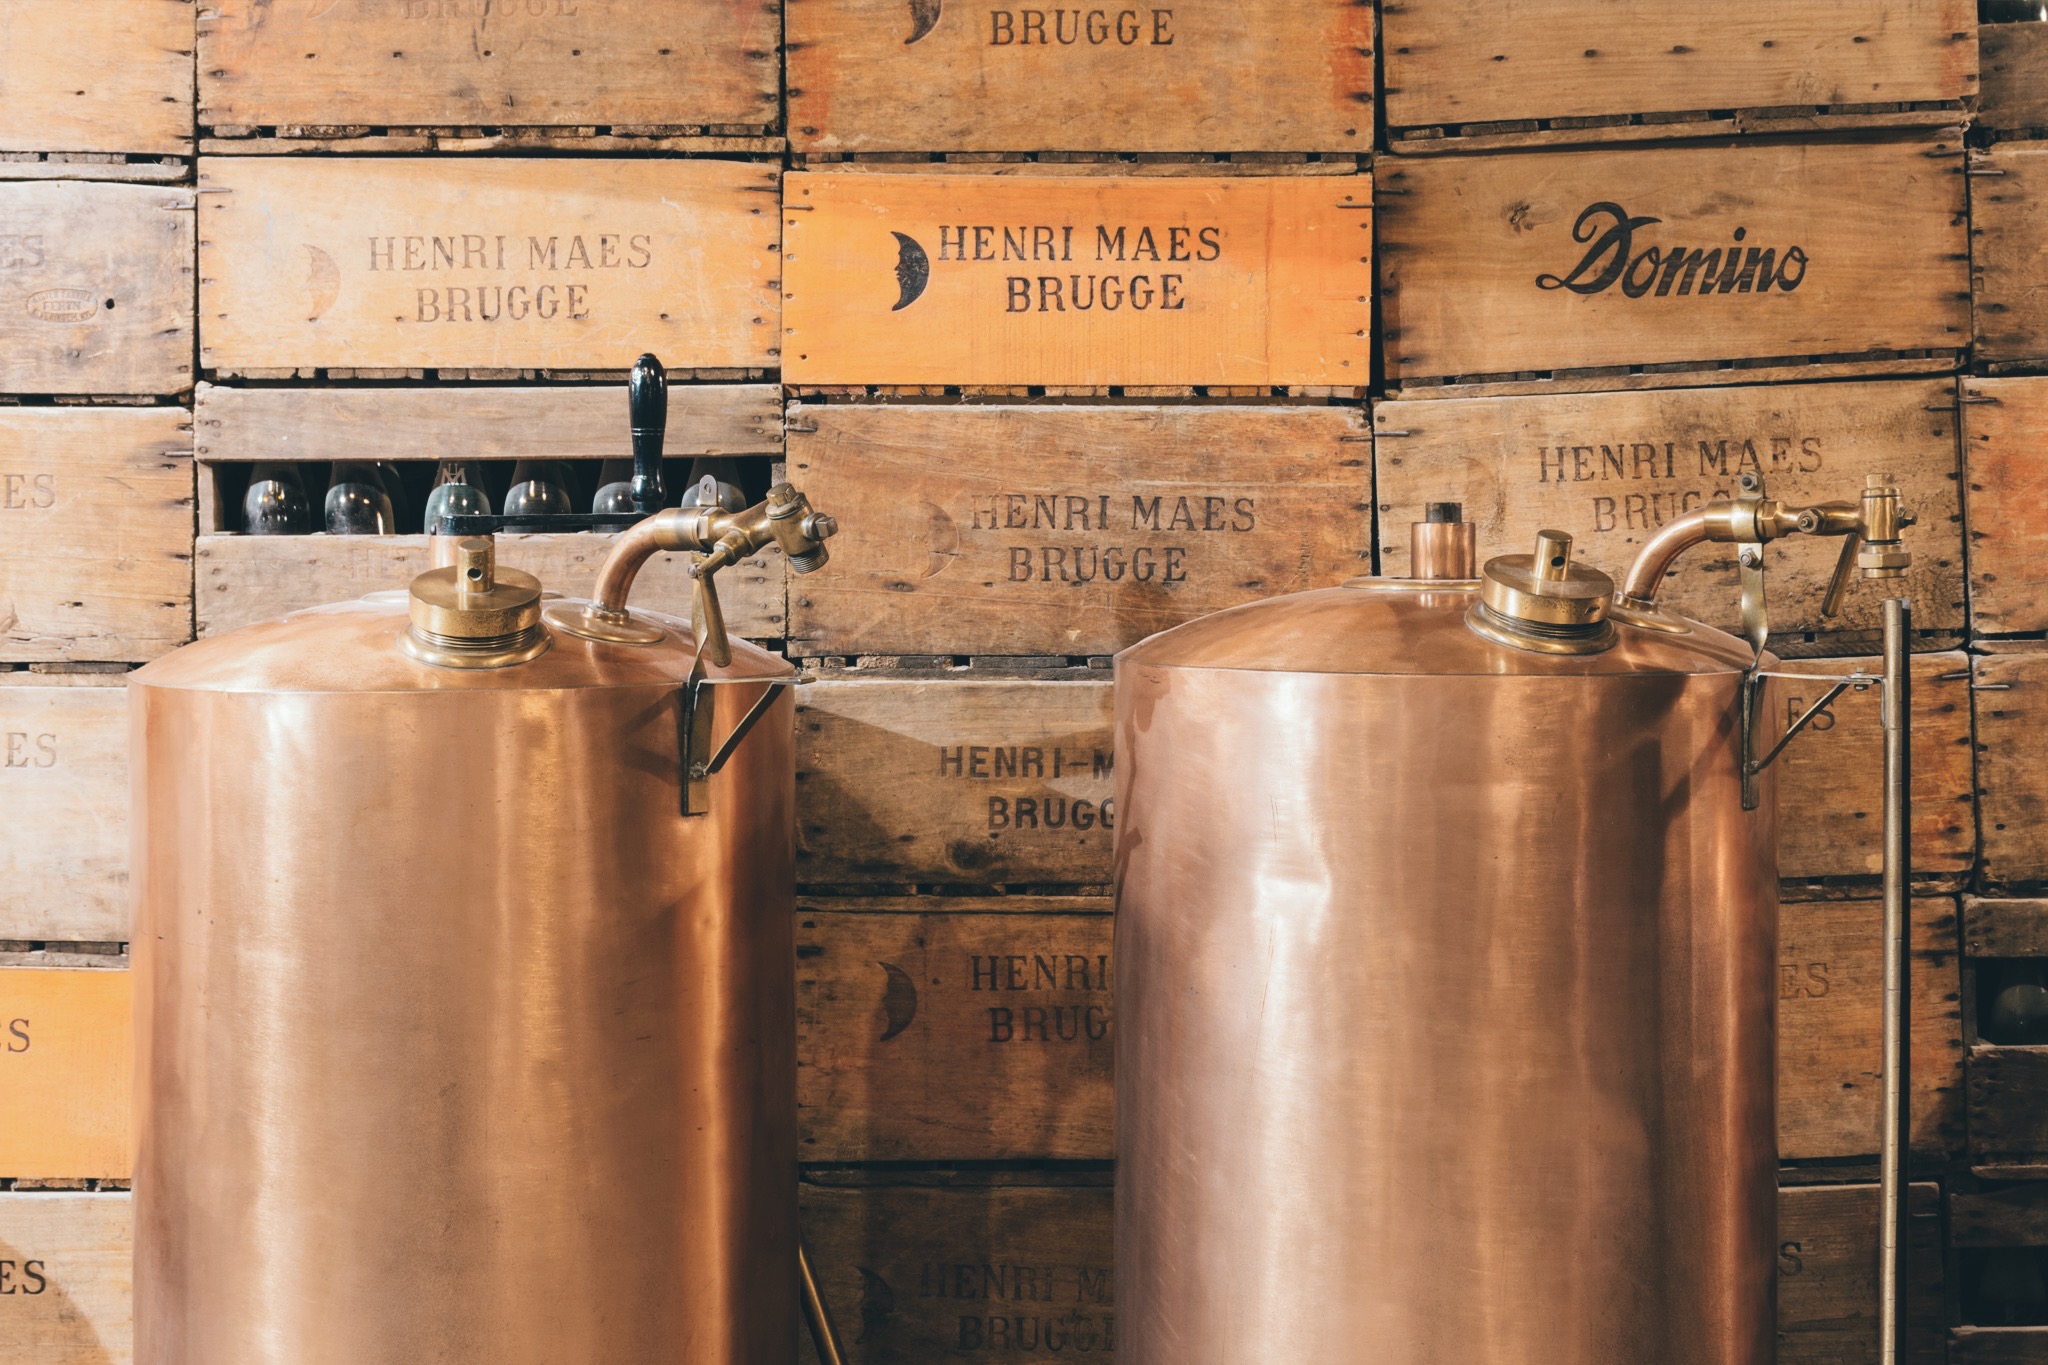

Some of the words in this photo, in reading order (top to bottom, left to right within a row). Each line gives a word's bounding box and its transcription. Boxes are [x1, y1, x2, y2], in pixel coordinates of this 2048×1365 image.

[990, 9, 1175, 45] BRUGGE
[368, 234, 506, 271] HENRI
[528, 233, 651, 271] MAES
[938, 225, 1073, 261] HENRI
[1096, 224, 1220, 261] MAES
[1535, 201, 1809, 298] Domino
[416, 284, 590, 322] BRUGGE
[1006, 274, 1185, 312] BRUGGE
[1538, 442, 1675, 482] HENRI
[1698, 437, 1822, 476] MAES
[3, 474, 55, 508] ES
[971, 494, 1110, 531] HENRI
[1131, 495, 1256, 532] MAES
[1592, 489, 1730, 532] BRUG
[1008, 546, 1186, 582] BRUGGE
[5, 732, 57, 768] ES
[971, 955, 1108, 991] HENRI
[0, 1018, 30, 1053] S
[988, 1005, 1109, 1042] BRUG
[919, 1263, 1053, 1302] HENRI
